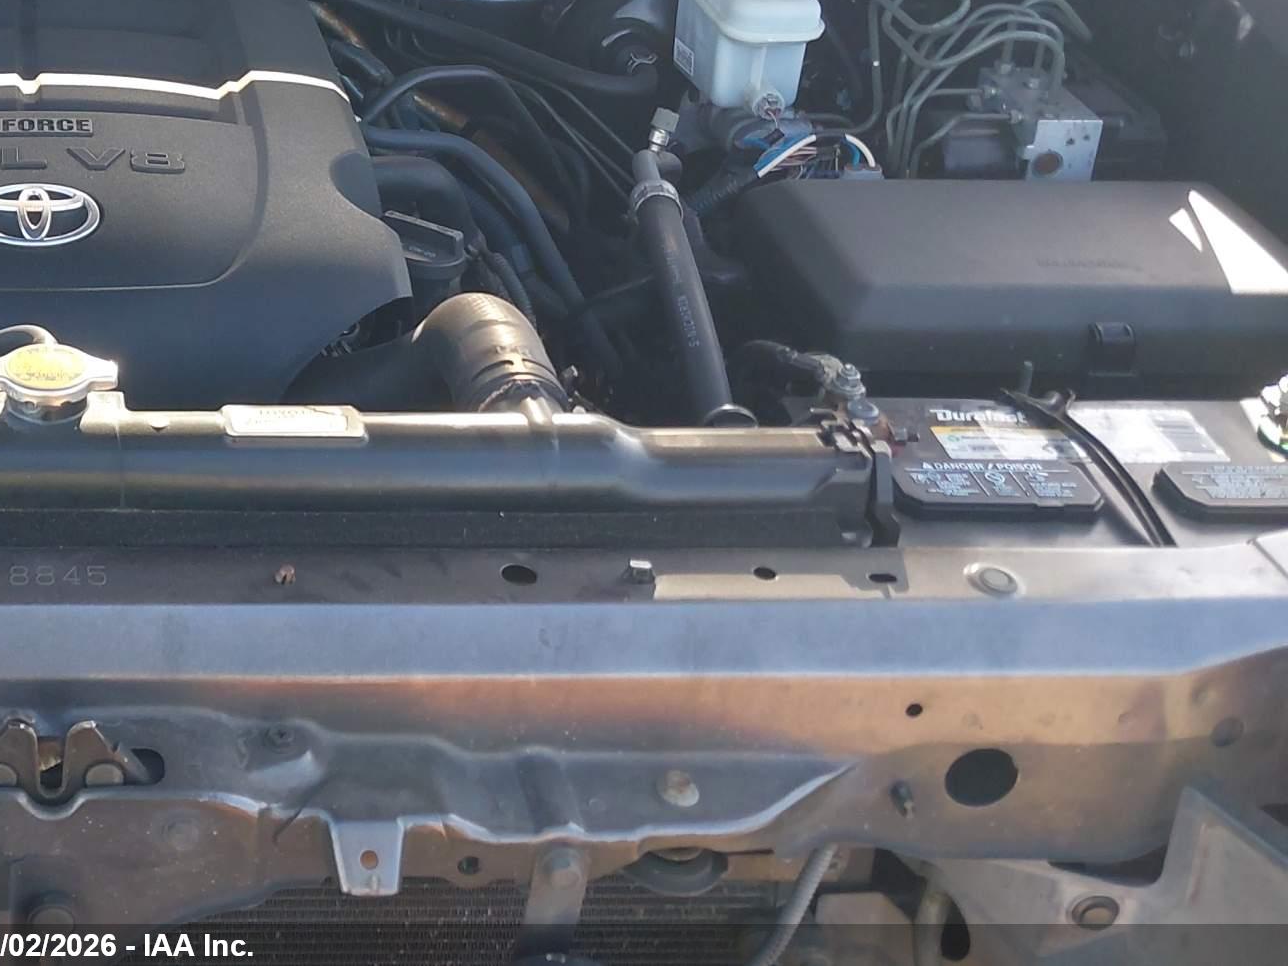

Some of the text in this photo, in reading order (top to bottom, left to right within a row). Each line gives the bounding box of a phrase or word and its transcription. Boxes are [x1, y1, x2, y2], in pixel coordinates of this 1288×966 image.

[66, 146, 187, 175] V8
[934, 461, 985, 471] DANGER
[996, 461, 1043, 471] POISON
